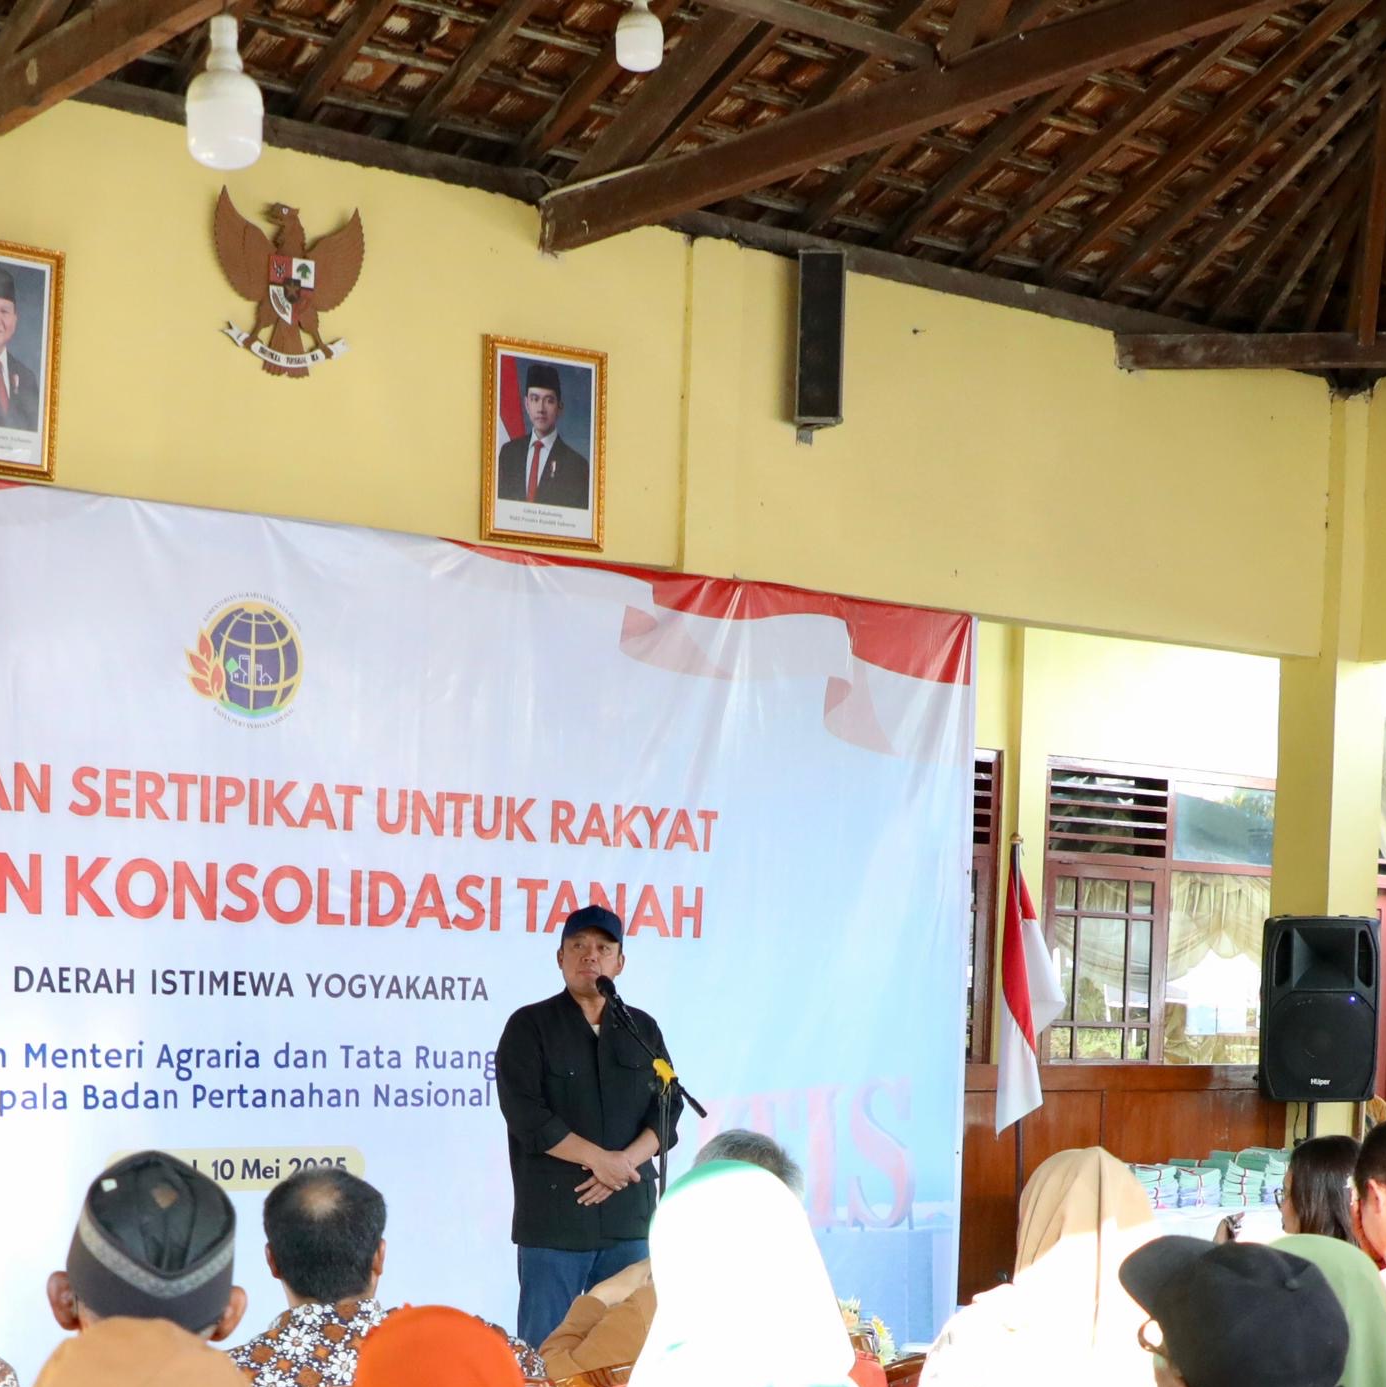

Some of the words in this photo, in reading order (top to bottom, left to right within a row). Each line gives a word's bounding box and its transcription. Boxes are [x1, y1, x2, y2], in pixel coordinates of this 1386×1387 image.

[69, 767, 362, 832] SERTIPIKAT
[377, 788, 536, 843] UNTUK
[551, 800, 718, 853] RAKYAT
[65, 855, 502, 932] KONSOLIDASI
[517, 878, 703, 938] TANAH
[13, 965, 135, 995] DAERAH
[151, 968, 295, 998] ISTIMEWA
[305, 972, 489, 1001] YOGYAKARTA
[24, 1040, 144, 1069] Menteri
[156, 1040, 261, 1082] Agraria
[273, 1042, 327, 1069] dan
[340, 1045, 402, 1070] Tata
[415, 1045, 497, 1081] Ruang
[83, 1082, 178, 1110] Badan
[192, 1082, 360, 1109] Pertanahan
[374, 1081, 491, 1108] Nasional
[211, 1158, 235, 1181] 10
[241, 1158, 280, 1180] Mei
